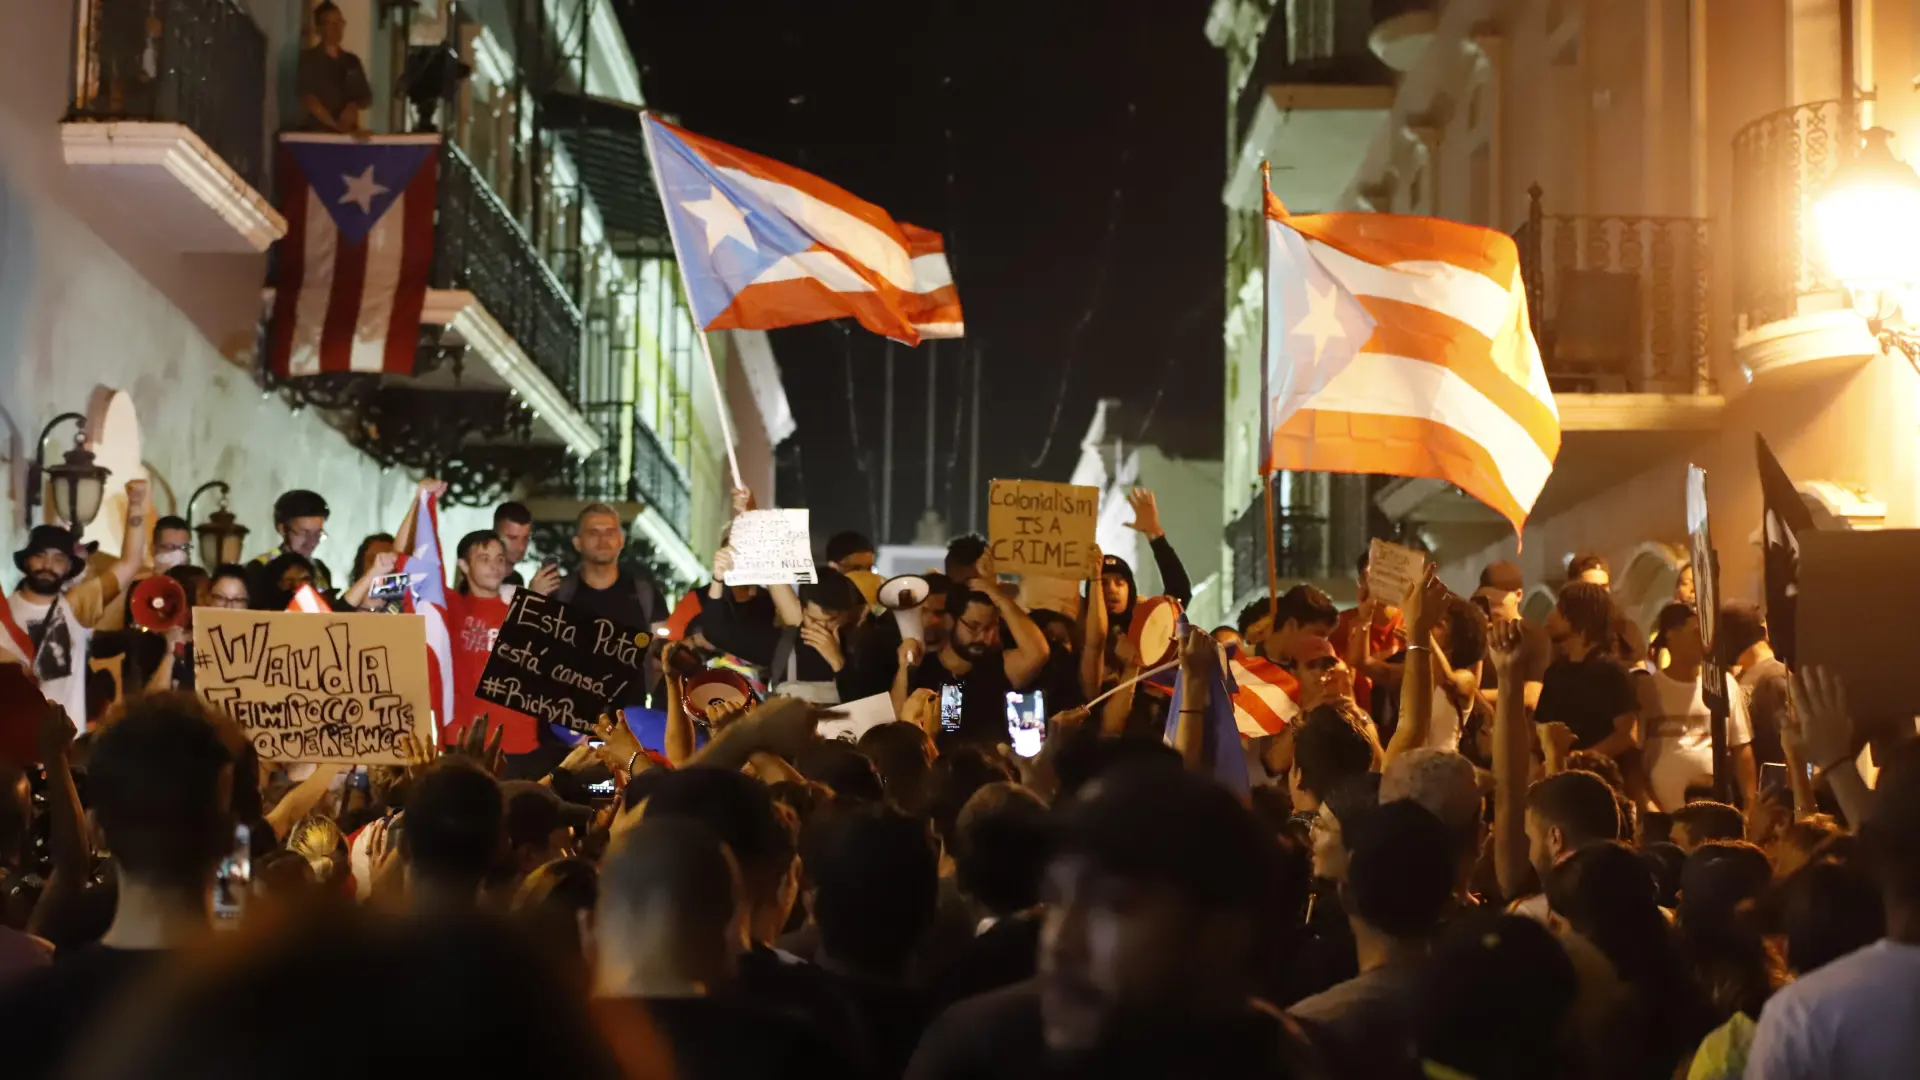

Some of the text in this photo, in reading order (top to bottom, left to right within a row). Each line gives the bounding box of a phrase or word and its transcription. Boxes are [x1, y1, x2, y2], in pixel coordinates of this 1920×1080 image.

[990, 484, 1092, 516] Colonialism
[1015, 516, 1062, 535] IS A
[991, 538, 1081, 568] CRIME
[505, 595, 577, 647] ¡Esta
[593, 618, 638, 669] Puta
[497, 640, 628, 703] está cansá!
[369, 694, 416, 732] TE
[482, 676, 594, 730] #RickyRen
